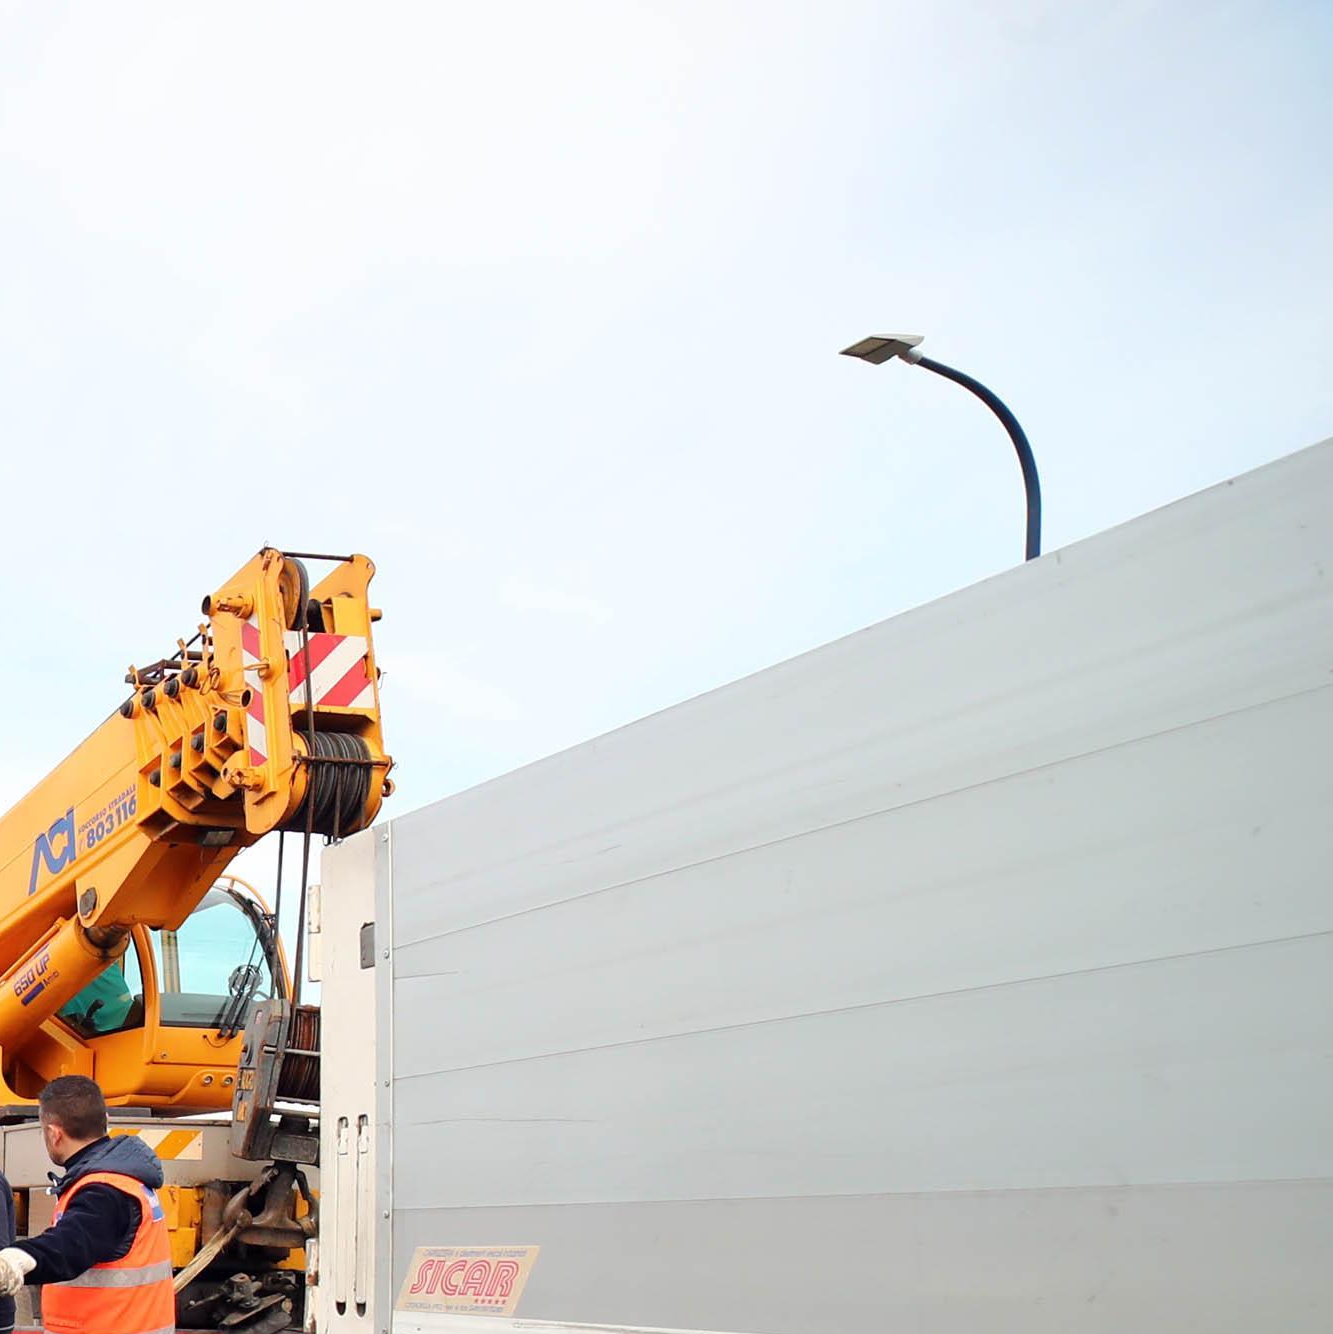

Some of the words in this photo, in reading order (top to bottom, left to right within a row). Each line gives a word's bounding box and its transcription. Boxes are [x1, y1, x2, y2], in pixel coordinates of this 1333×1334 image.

[13, 969, 36, 997] 650
[36, 953, 50, 977] UP
[409, 1259, 520, 1297] SICAR
